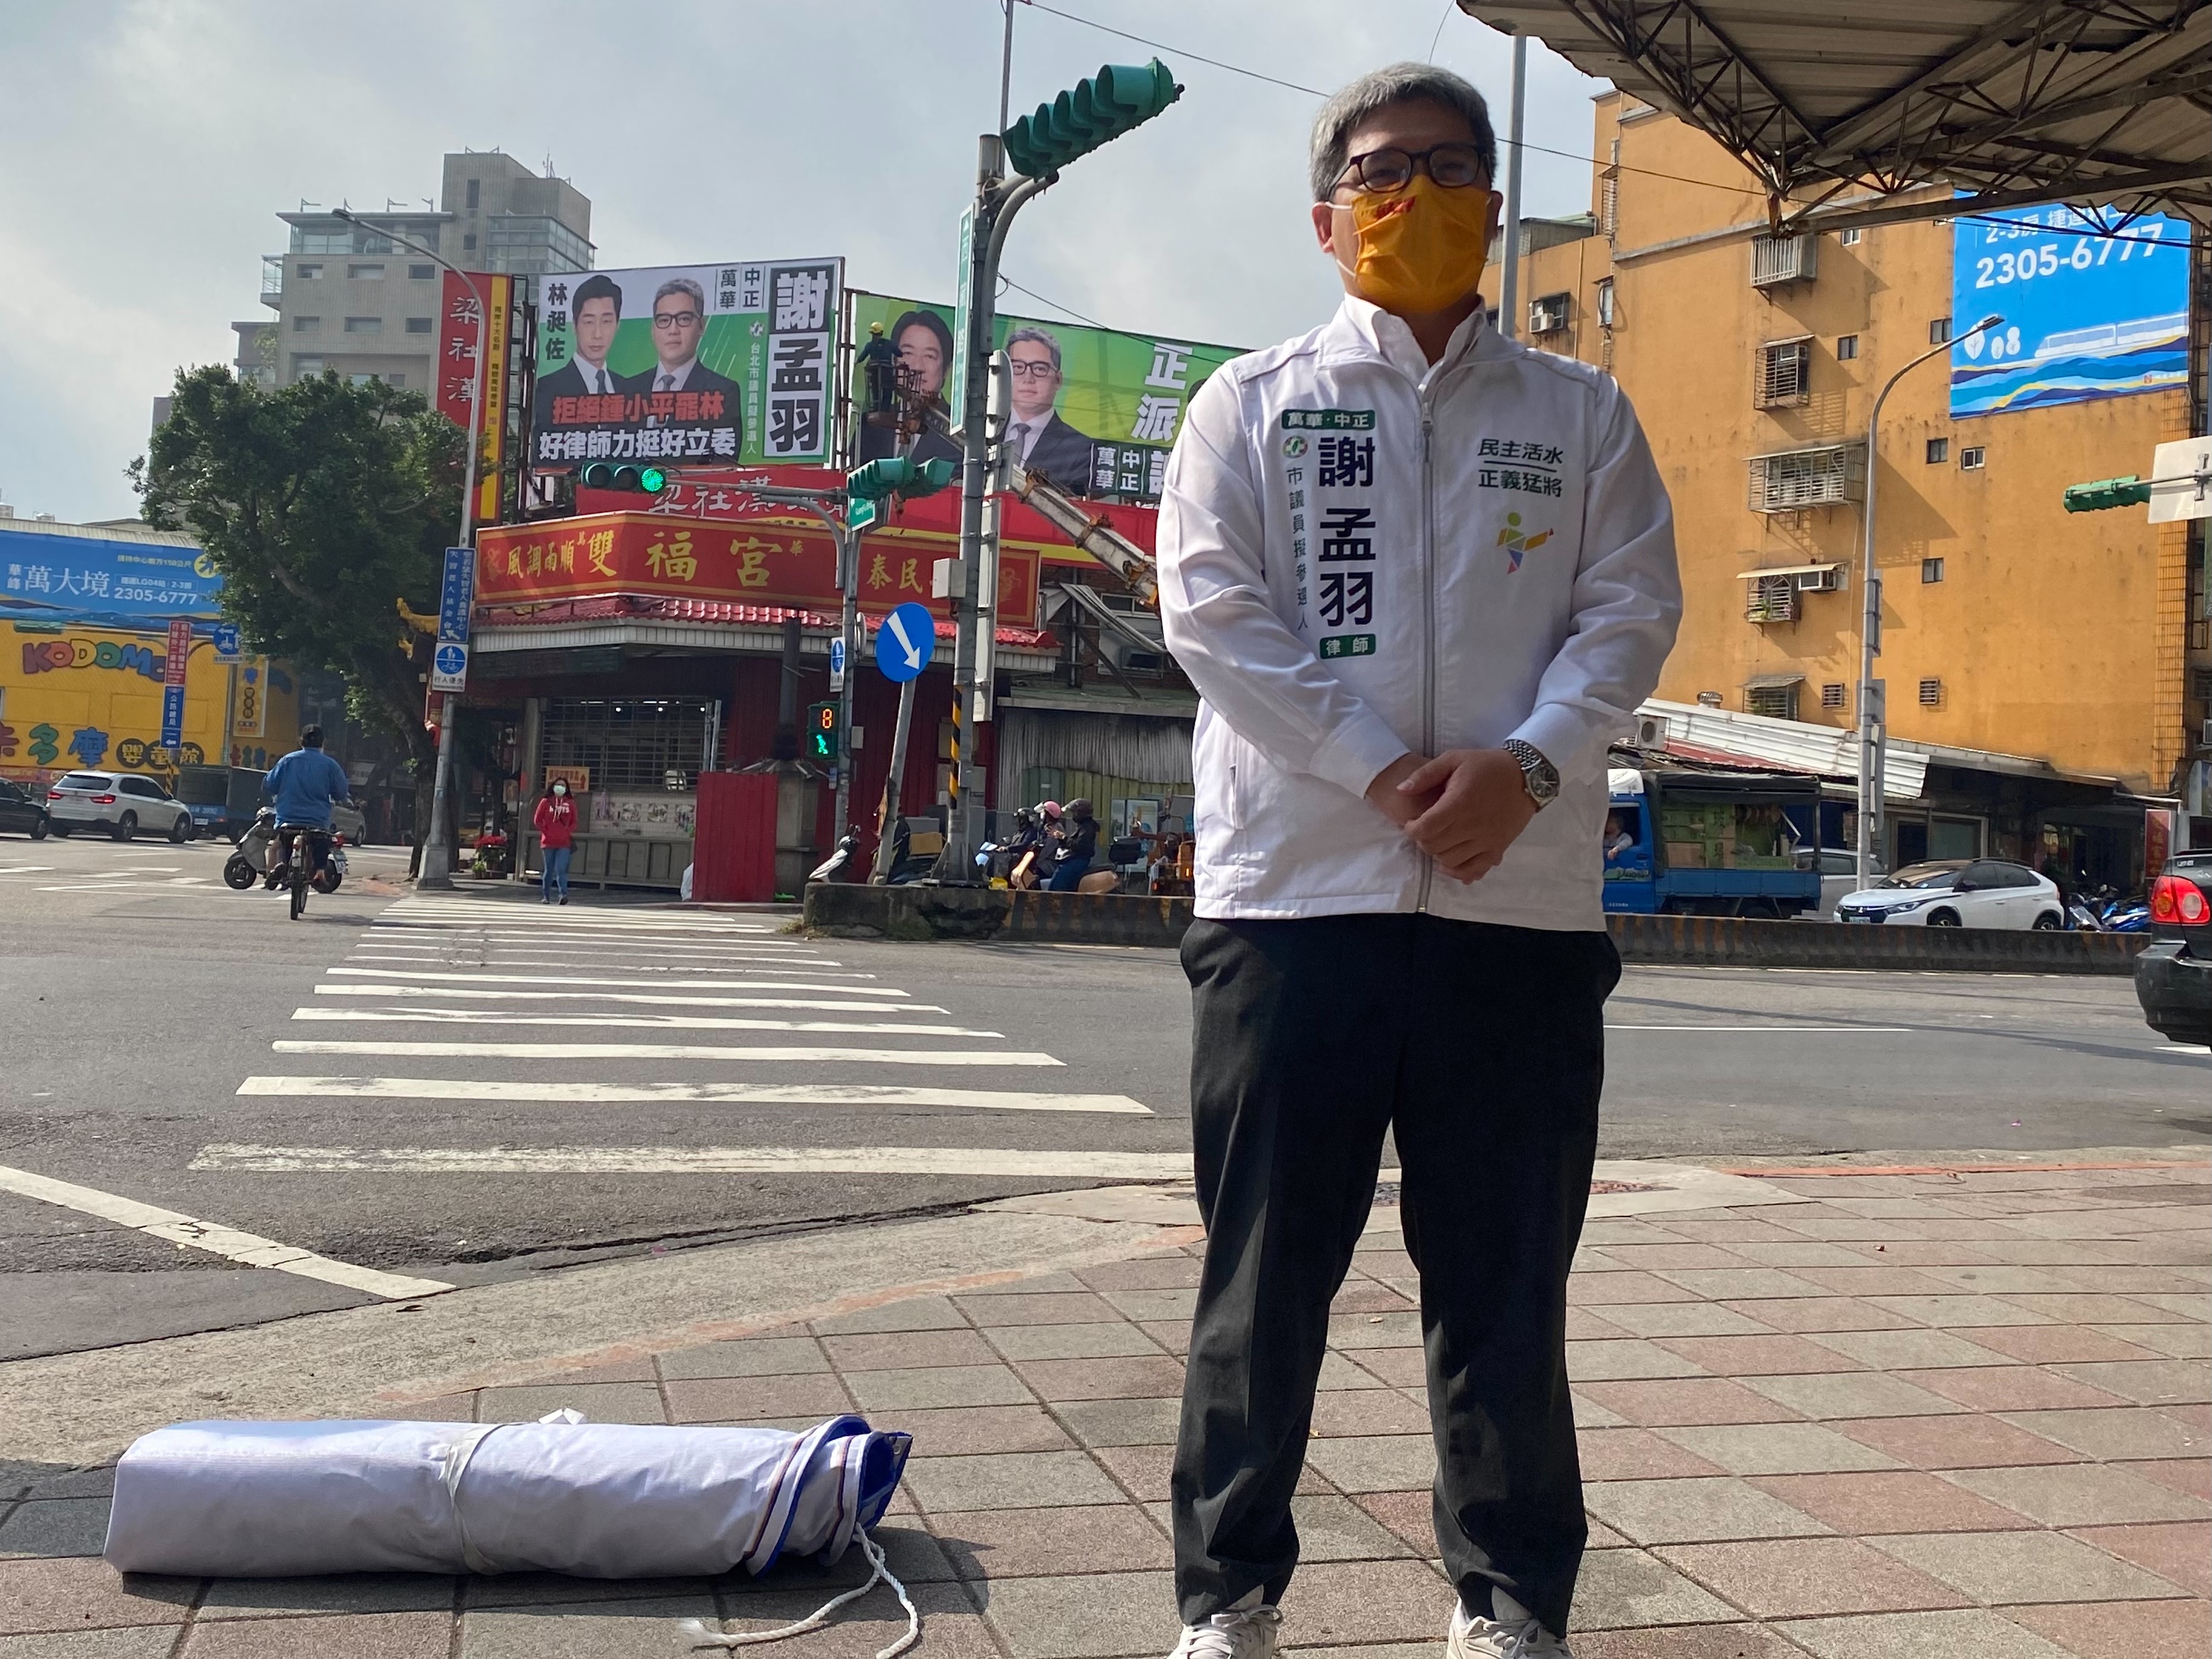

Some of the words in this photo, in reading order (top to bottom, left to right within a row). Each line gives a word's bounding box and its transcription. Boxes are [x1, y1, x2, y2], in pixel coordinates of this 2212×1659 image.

[2047, 207, 2129, 229] 捷運精
[1975, 222, 2164, 289] 2305-6777
[719, 269, 738, 309] 萬華
[742, 269, 761, 308] 中正
[545, 283, 568, 360] 林昶佐
[768, 270, 829, 452] 謝孟羽
[552, 391, 724, 424] 拒絕鍾小平罷林
[1130, 342, 1193, 443] 正派
[539, 427, 736, 460] 好律師力挺好立委
[1477, 438, 1563, 464] 民主活水
[1095, 447, 1117, 489] 萬華
[1120, 449, 1140, 492] 中正
[1478, 469, 1562, 498] 正義猛將
[1318, 437, 1376, 626] 謝孟羽
[24, 564, 110, 598] 萬大境
[507, 539, 574, 579] 風調雨順
[587, 530, 782, 587] 雙福宮
[866, 553, 932, 594] 泰民
[114, 586, 197, 605] 2305-6777
[22, 638, 167, 683] KODOMO
[1326, 637, 1369, 655] 律師
[822, 709, 832, 729] 8
